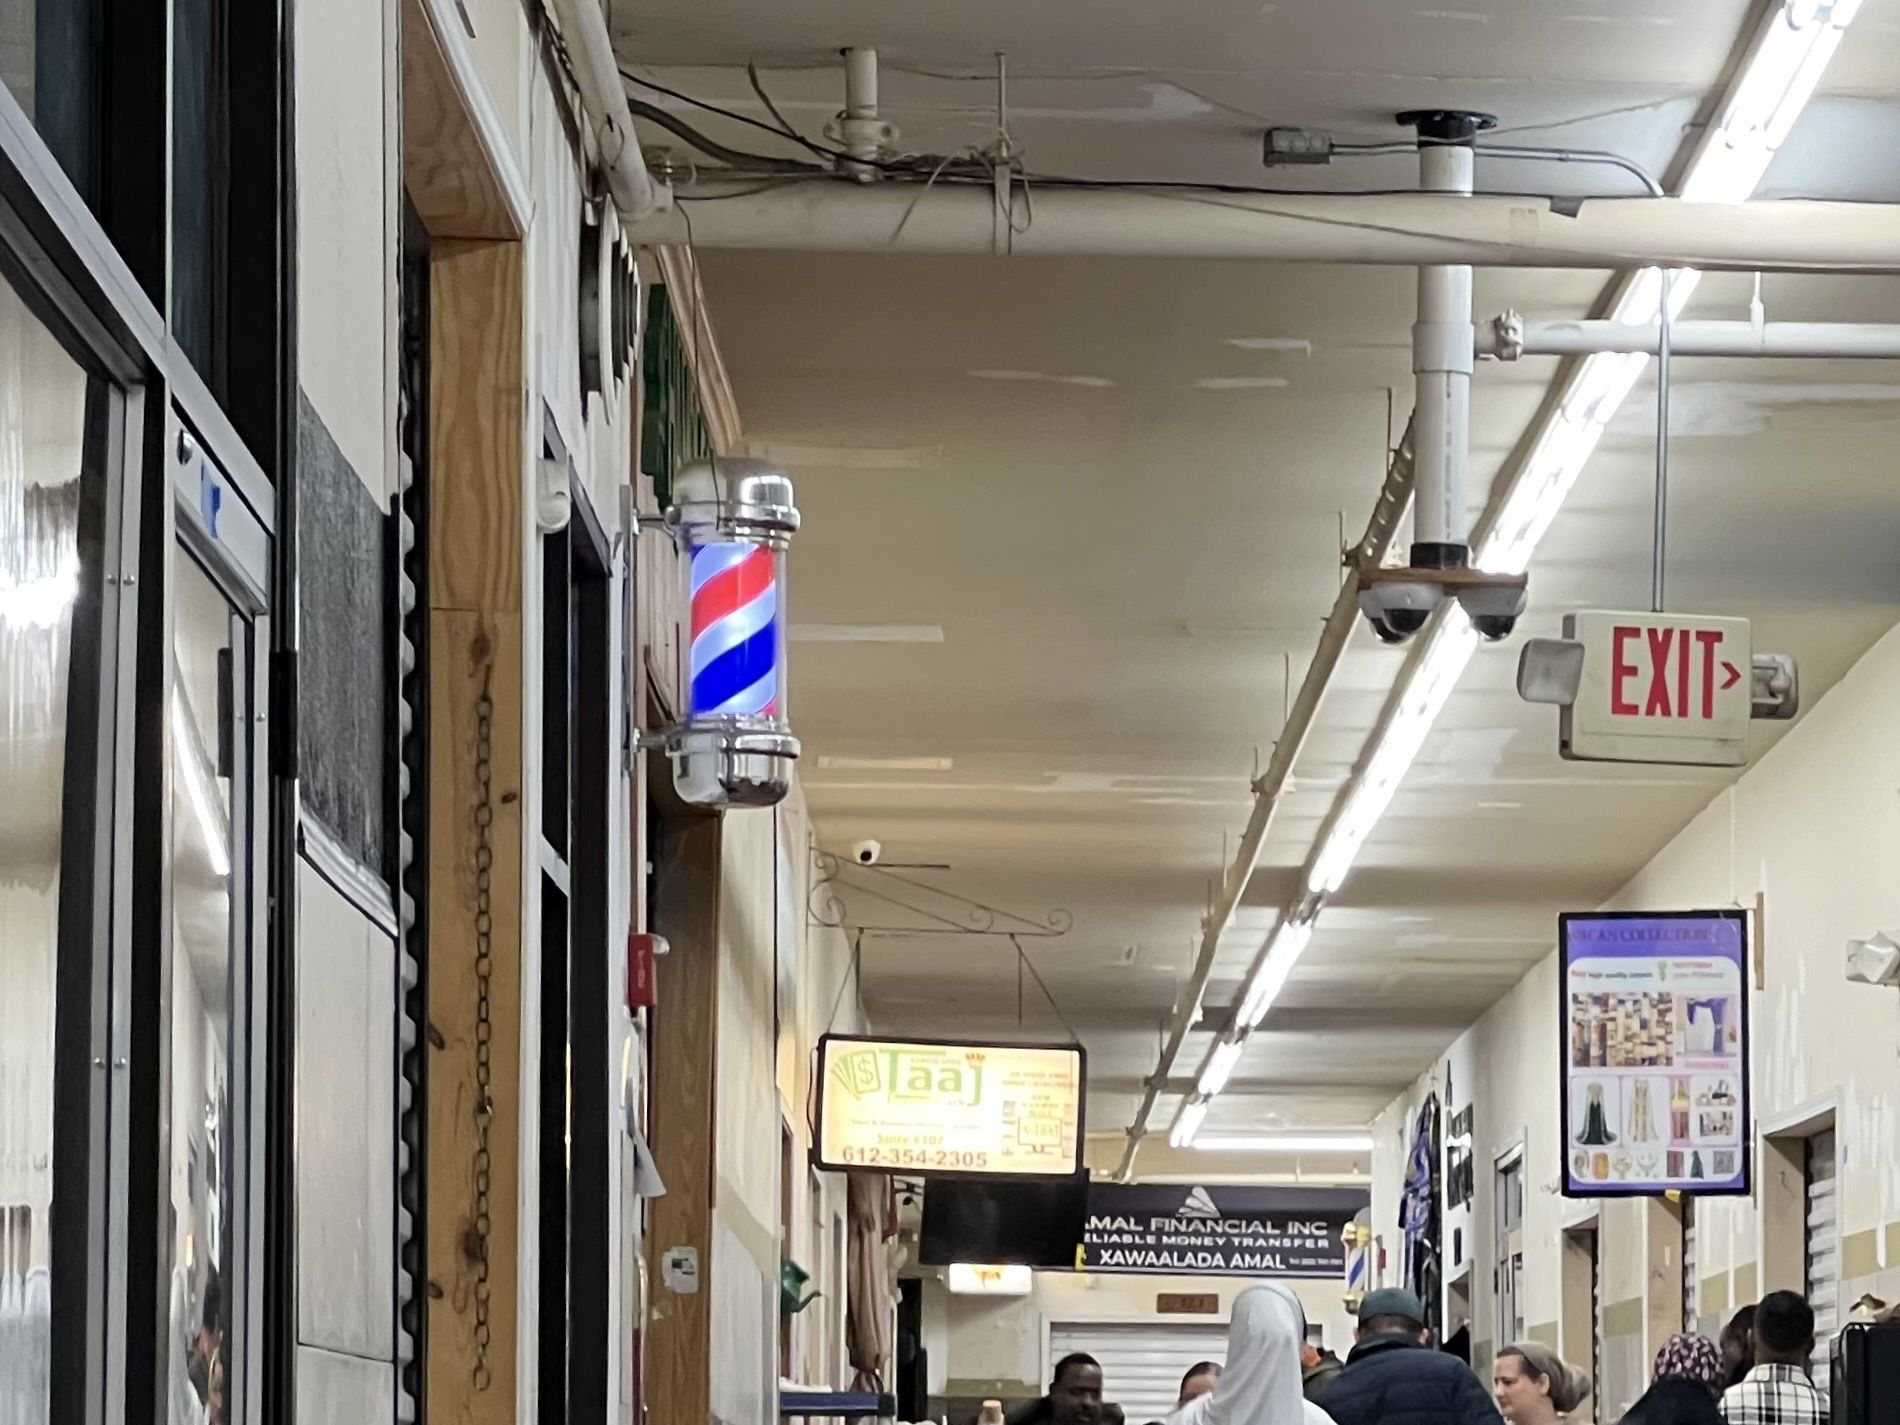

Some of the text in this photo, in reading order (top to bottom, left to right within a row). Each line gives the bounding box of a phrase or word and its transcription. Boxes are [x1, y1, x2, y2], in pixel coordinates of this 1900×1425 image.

[1611, 626, 1723, 719] EXIT
[843, 1147, 987, 1167] 612-354-2305
[1151, 1217, 1281, 1235] FINANCIAL
[1287, 1221, 1328, 1236] INC
[1162, 1235, 1227, 1246] MONEY
[1231, 1237, 1329, 1248] TRANSFER
[1100, 1248, 1226, 1269] XAWAALADA
[1230, 1253, 1287, 1270] AMAL
